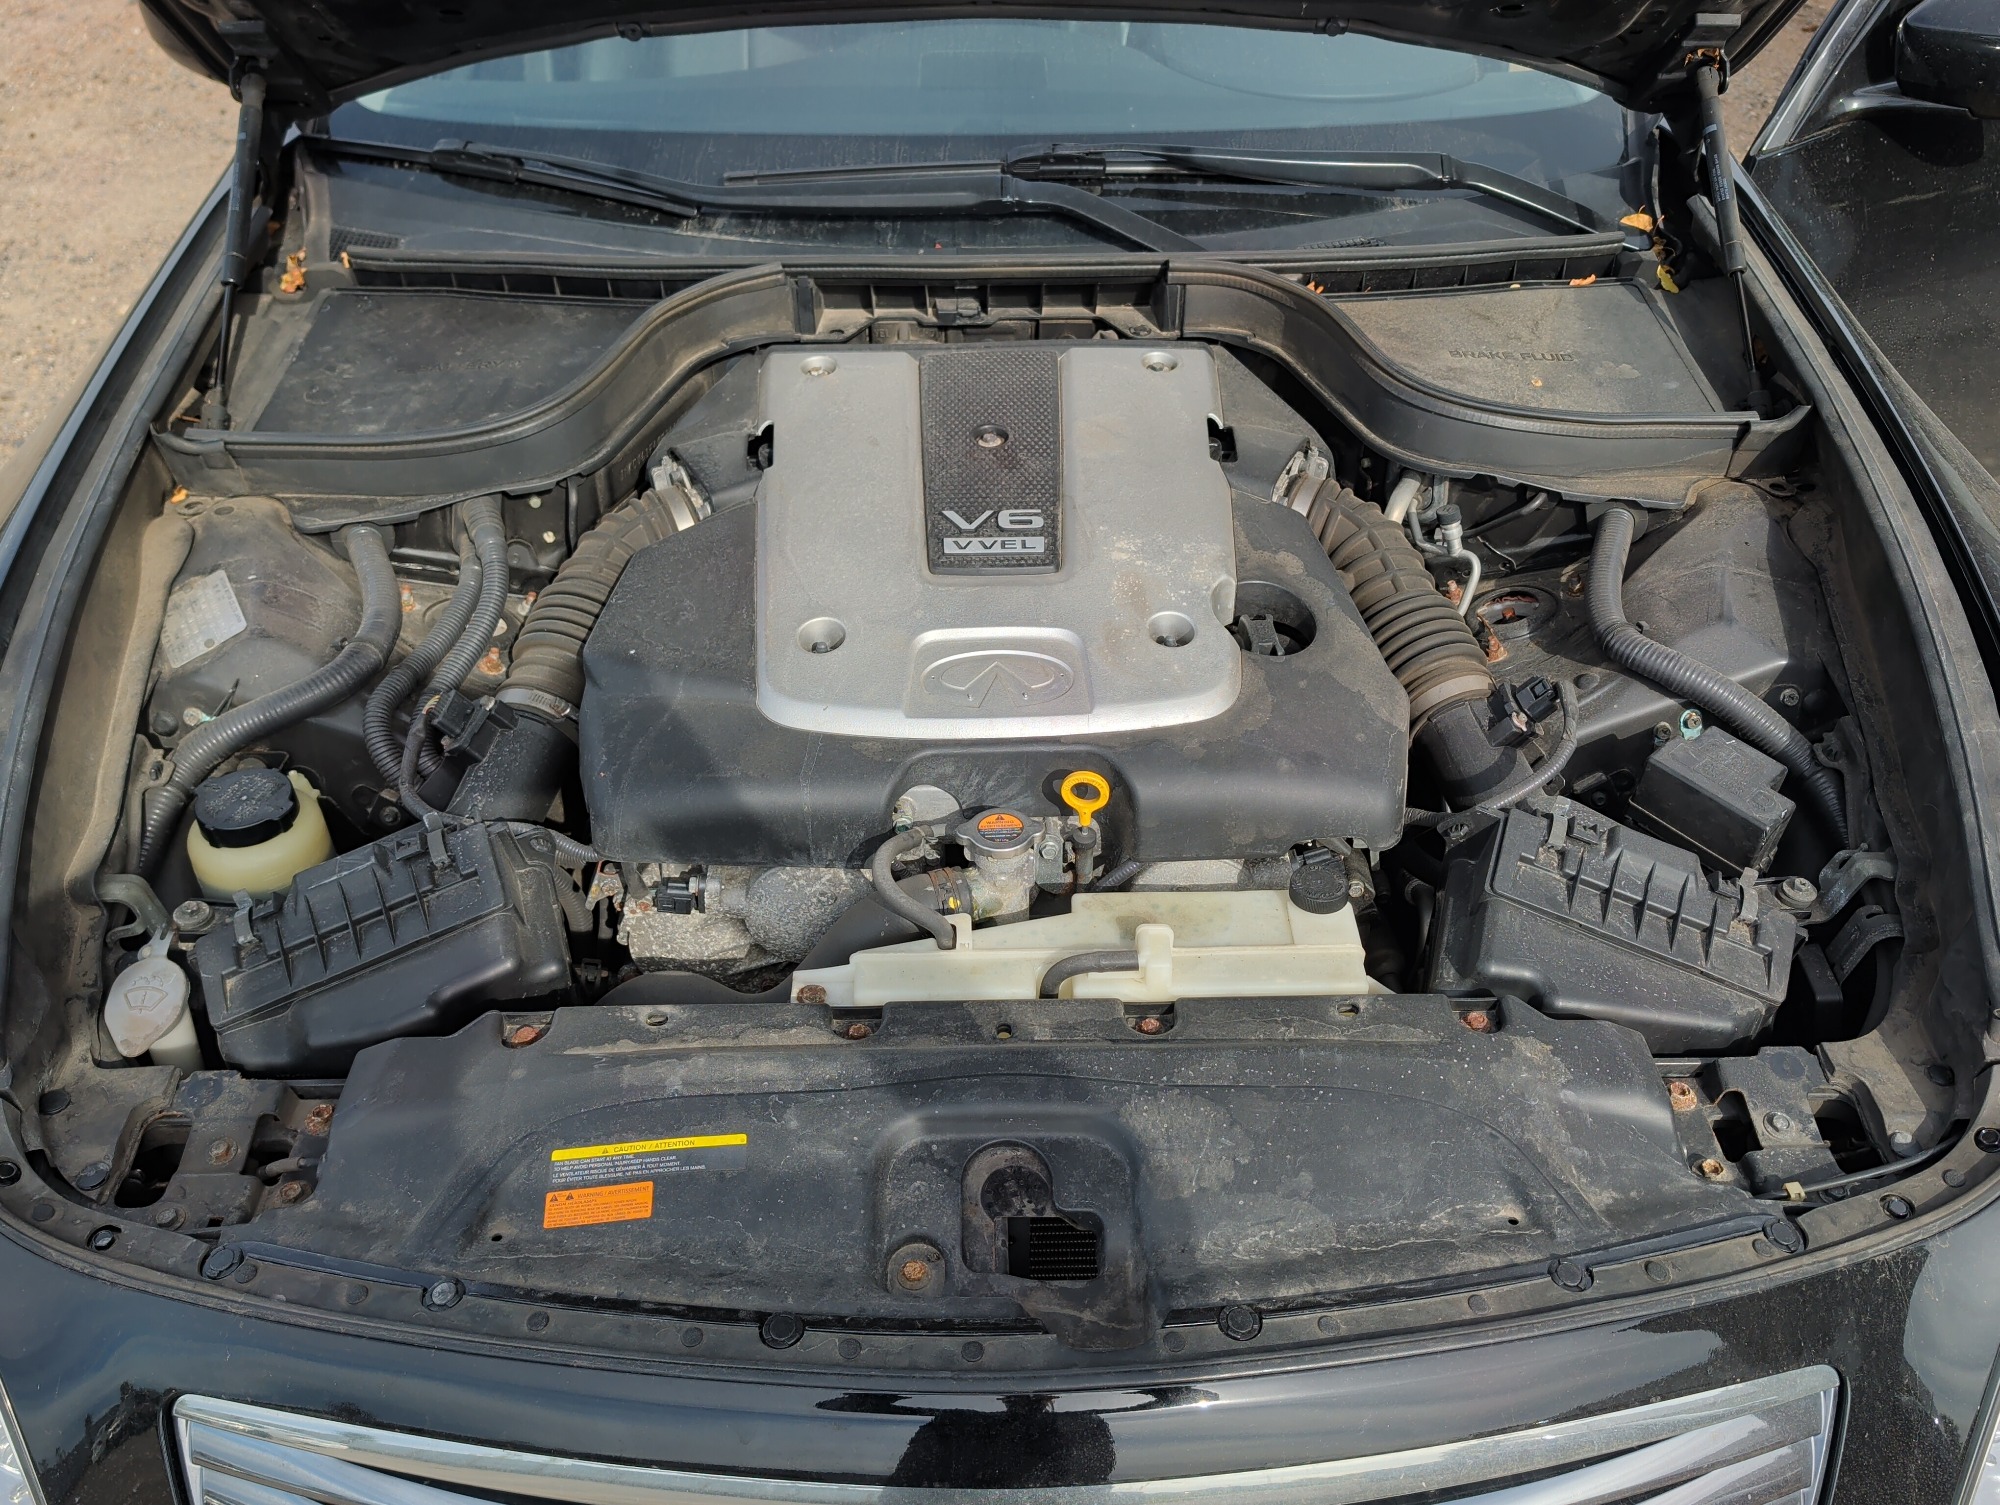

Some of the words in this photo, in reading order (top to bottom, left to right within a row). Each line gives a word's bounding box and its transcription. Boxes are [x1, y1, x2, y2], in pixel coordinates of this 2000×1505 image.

[1449, 350, 1514, 361] BRAKE
[1519, 351, 1575, 362] FLUID
[941, 508, 1045, 532] V6
[952, 539, 1037, 550] VVEL
[613, 1144, 646, 1153] CAUTION
[654, 1140, 695, 1149] ATTENTION
[578, 1191, 603, 1199] WARNING
[607, 1186, 650, 1195] AVERTISSEMENT
